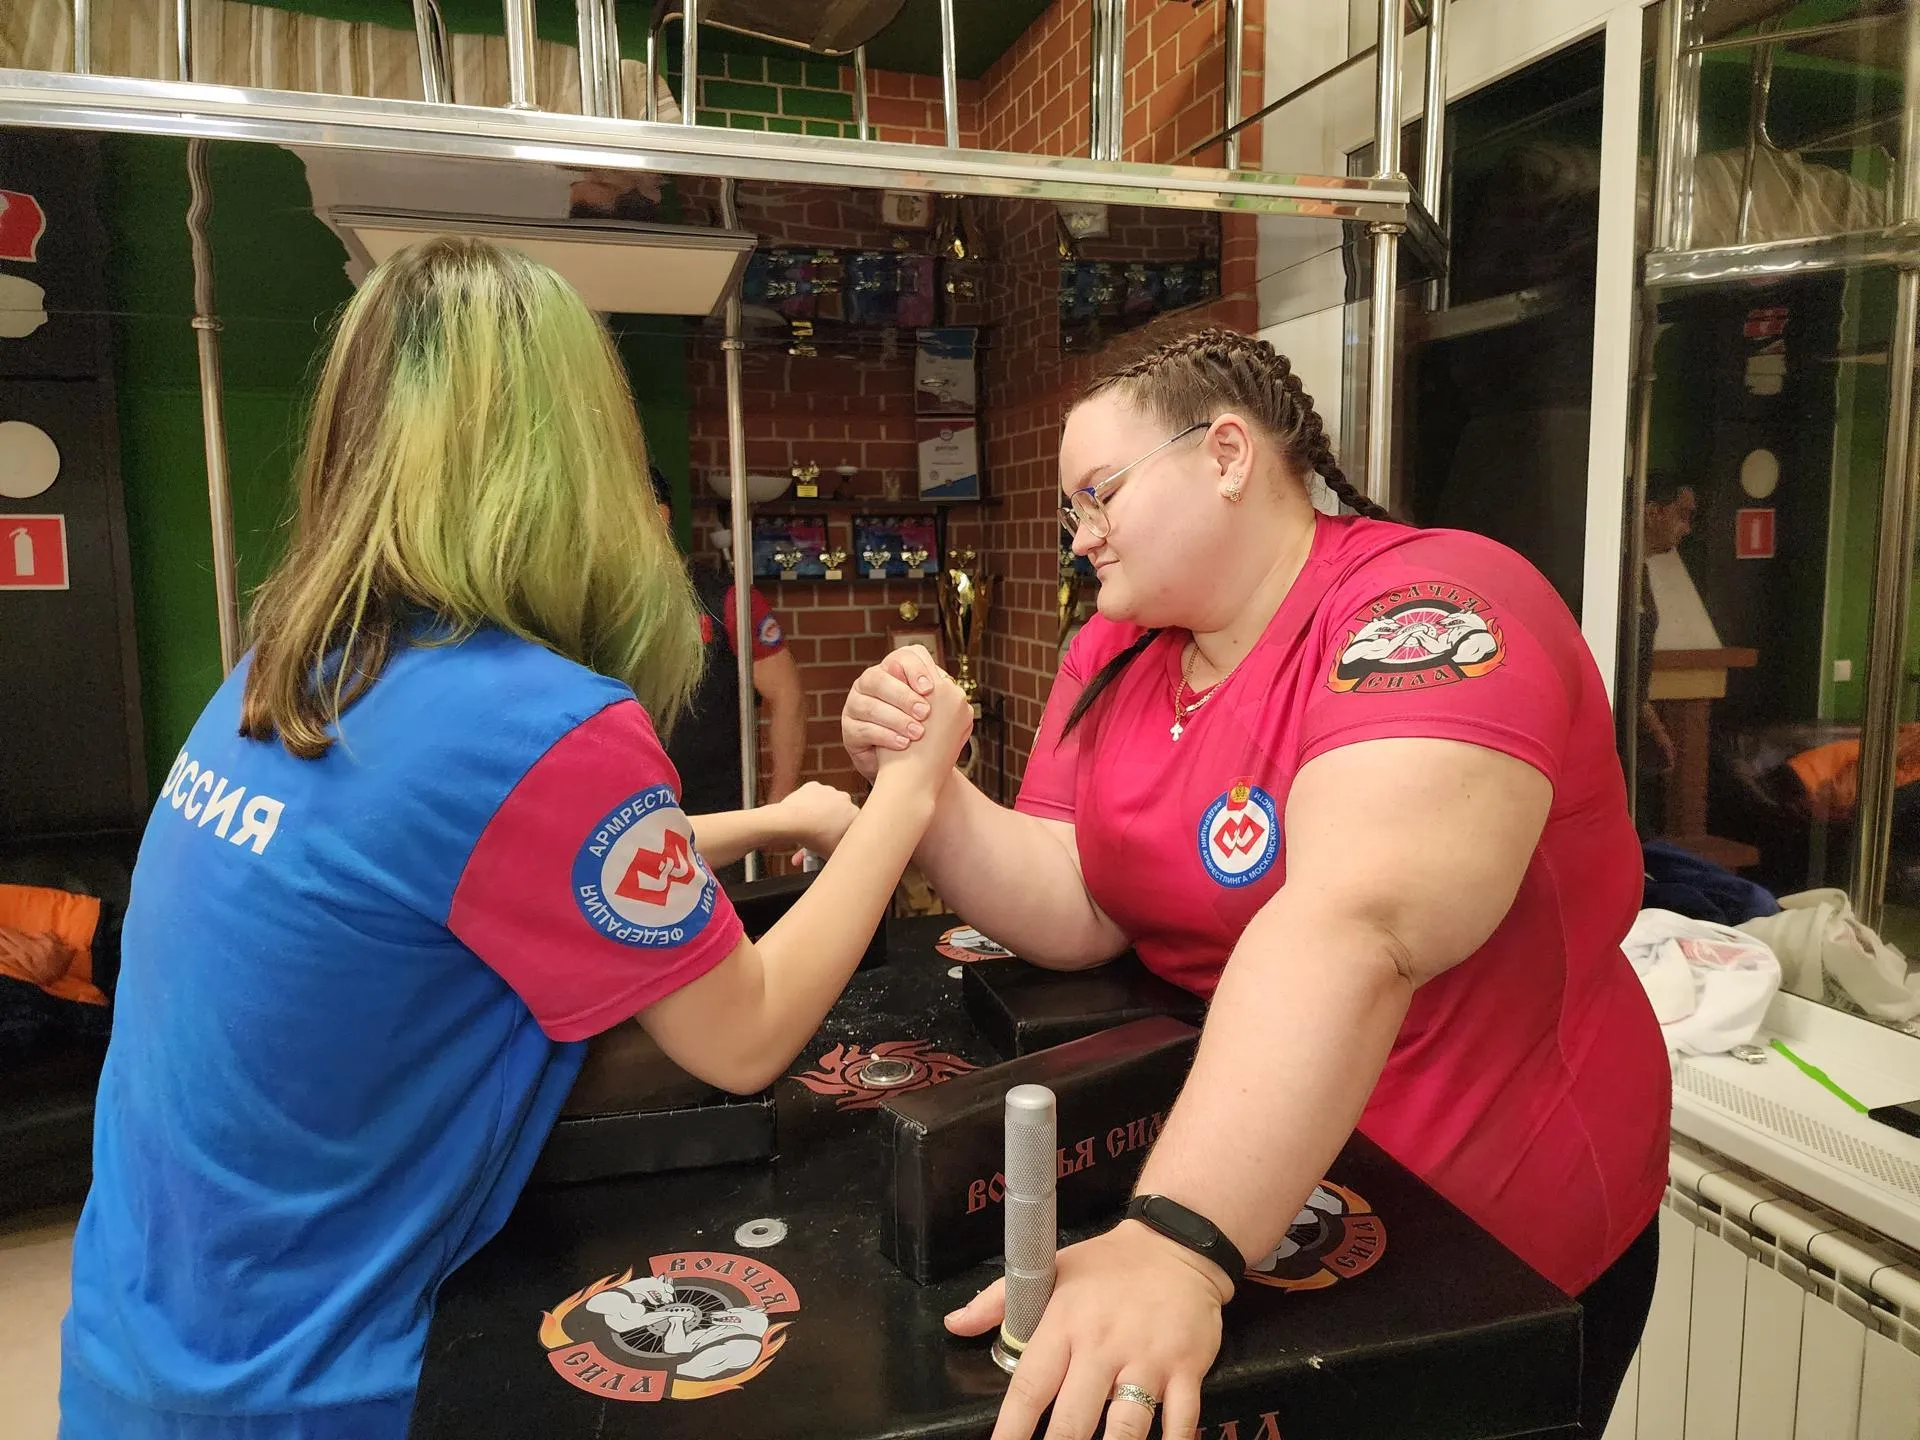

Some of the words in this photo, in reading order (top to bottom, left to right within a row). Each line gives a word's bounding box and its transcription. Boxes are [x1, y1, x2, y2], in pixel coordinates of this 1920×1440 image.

[1366, 668, 1450, 689] СИЛА
[161, 751, 286, 856] ОССИЯ
[1200, 801, 1222, 848] ФЕДЕРАЦИЯ
[1202, 850, 1249, 885] АРМРЕСТЛИНГА
[579, 884, 684, 945] ФЕДЕРАЦИЯ
[965, 1136, 1096, 1215] ВОЬЯ
[1106, 1111, 1166, 1158] СИЛ
[1335, 1221, 1379, 1269] СИЛА
[669, 1256, 788, 1310] ВОЛЧЬЯ
[563, 1350, 653, 1393] СИЛА
